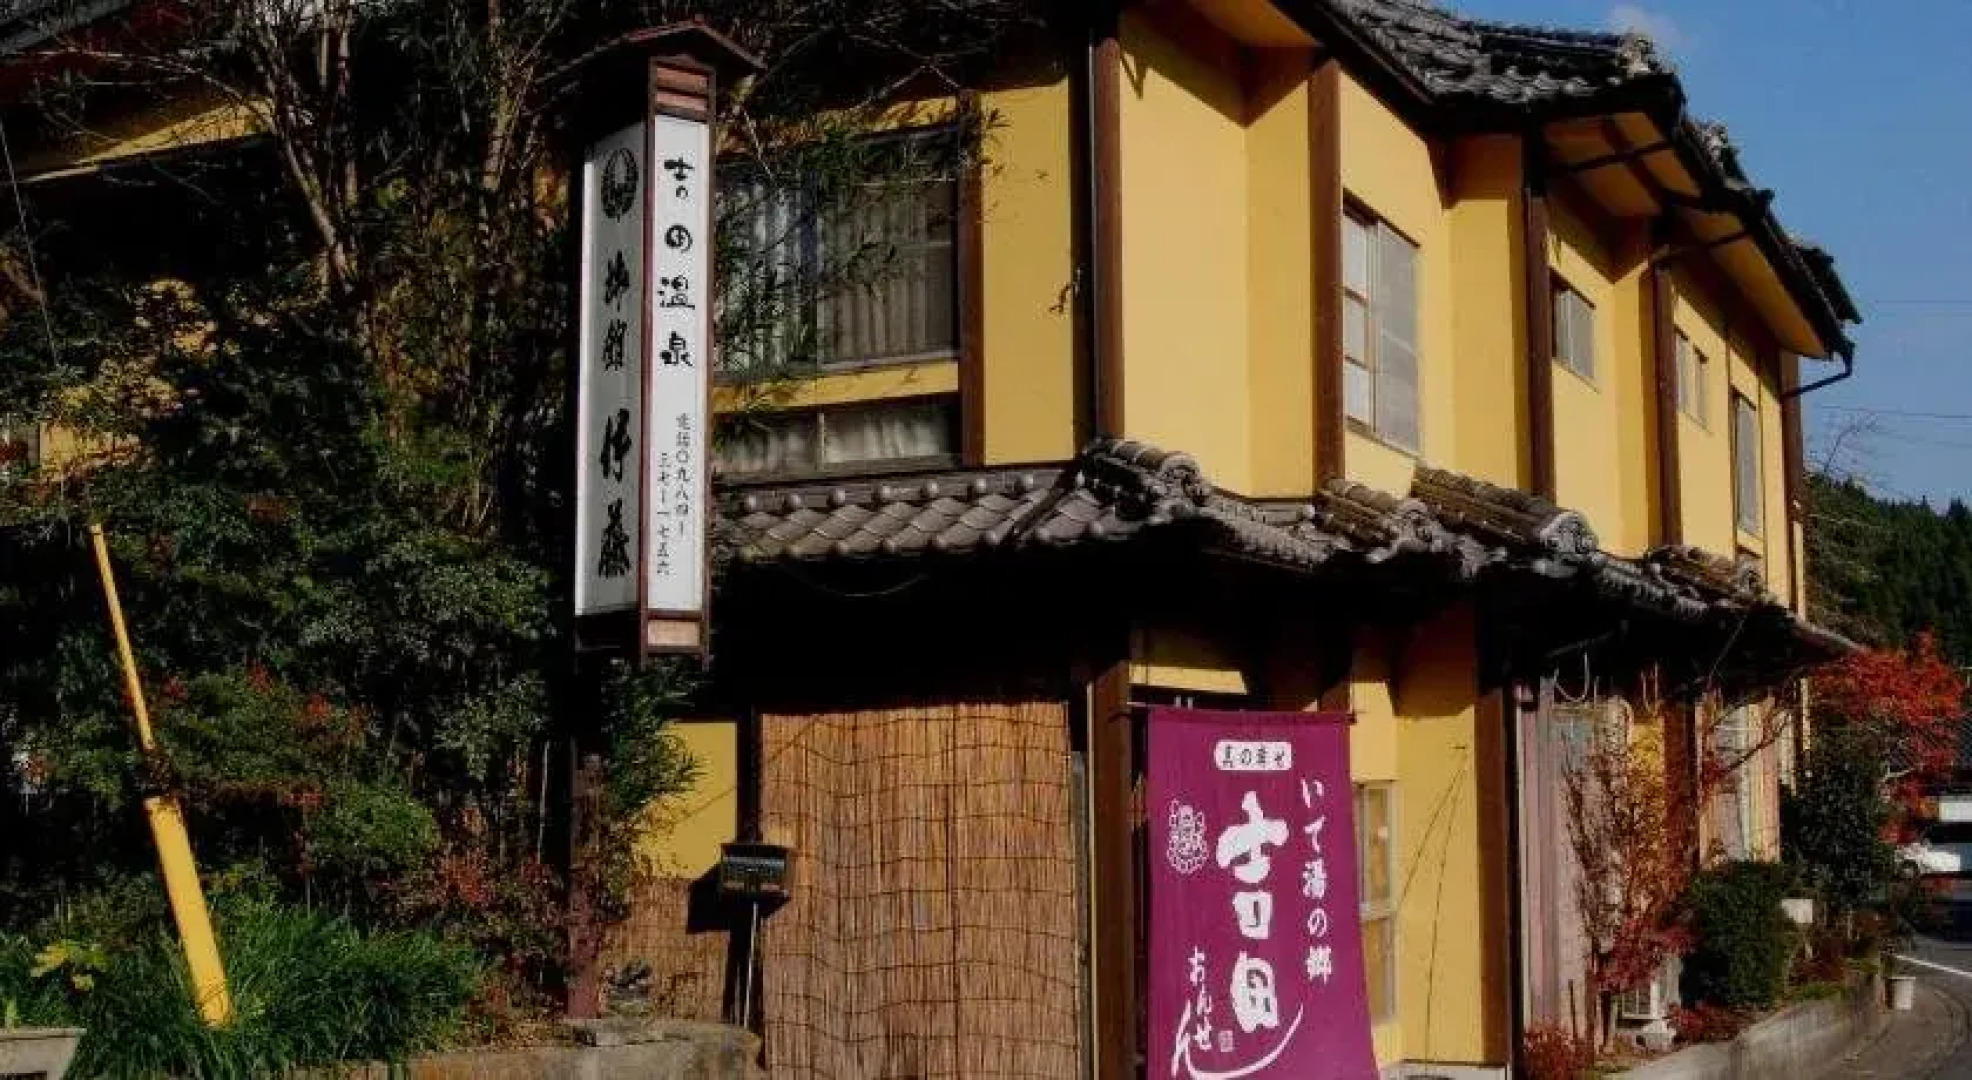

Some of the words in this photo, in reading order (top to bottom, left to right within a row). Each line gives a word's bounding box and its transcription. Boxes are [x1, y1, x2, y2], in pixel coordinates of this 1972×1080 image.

[657, 156, 696, 366] 吉田温泉
[1215, 790, 1290, 1034] 吉田
